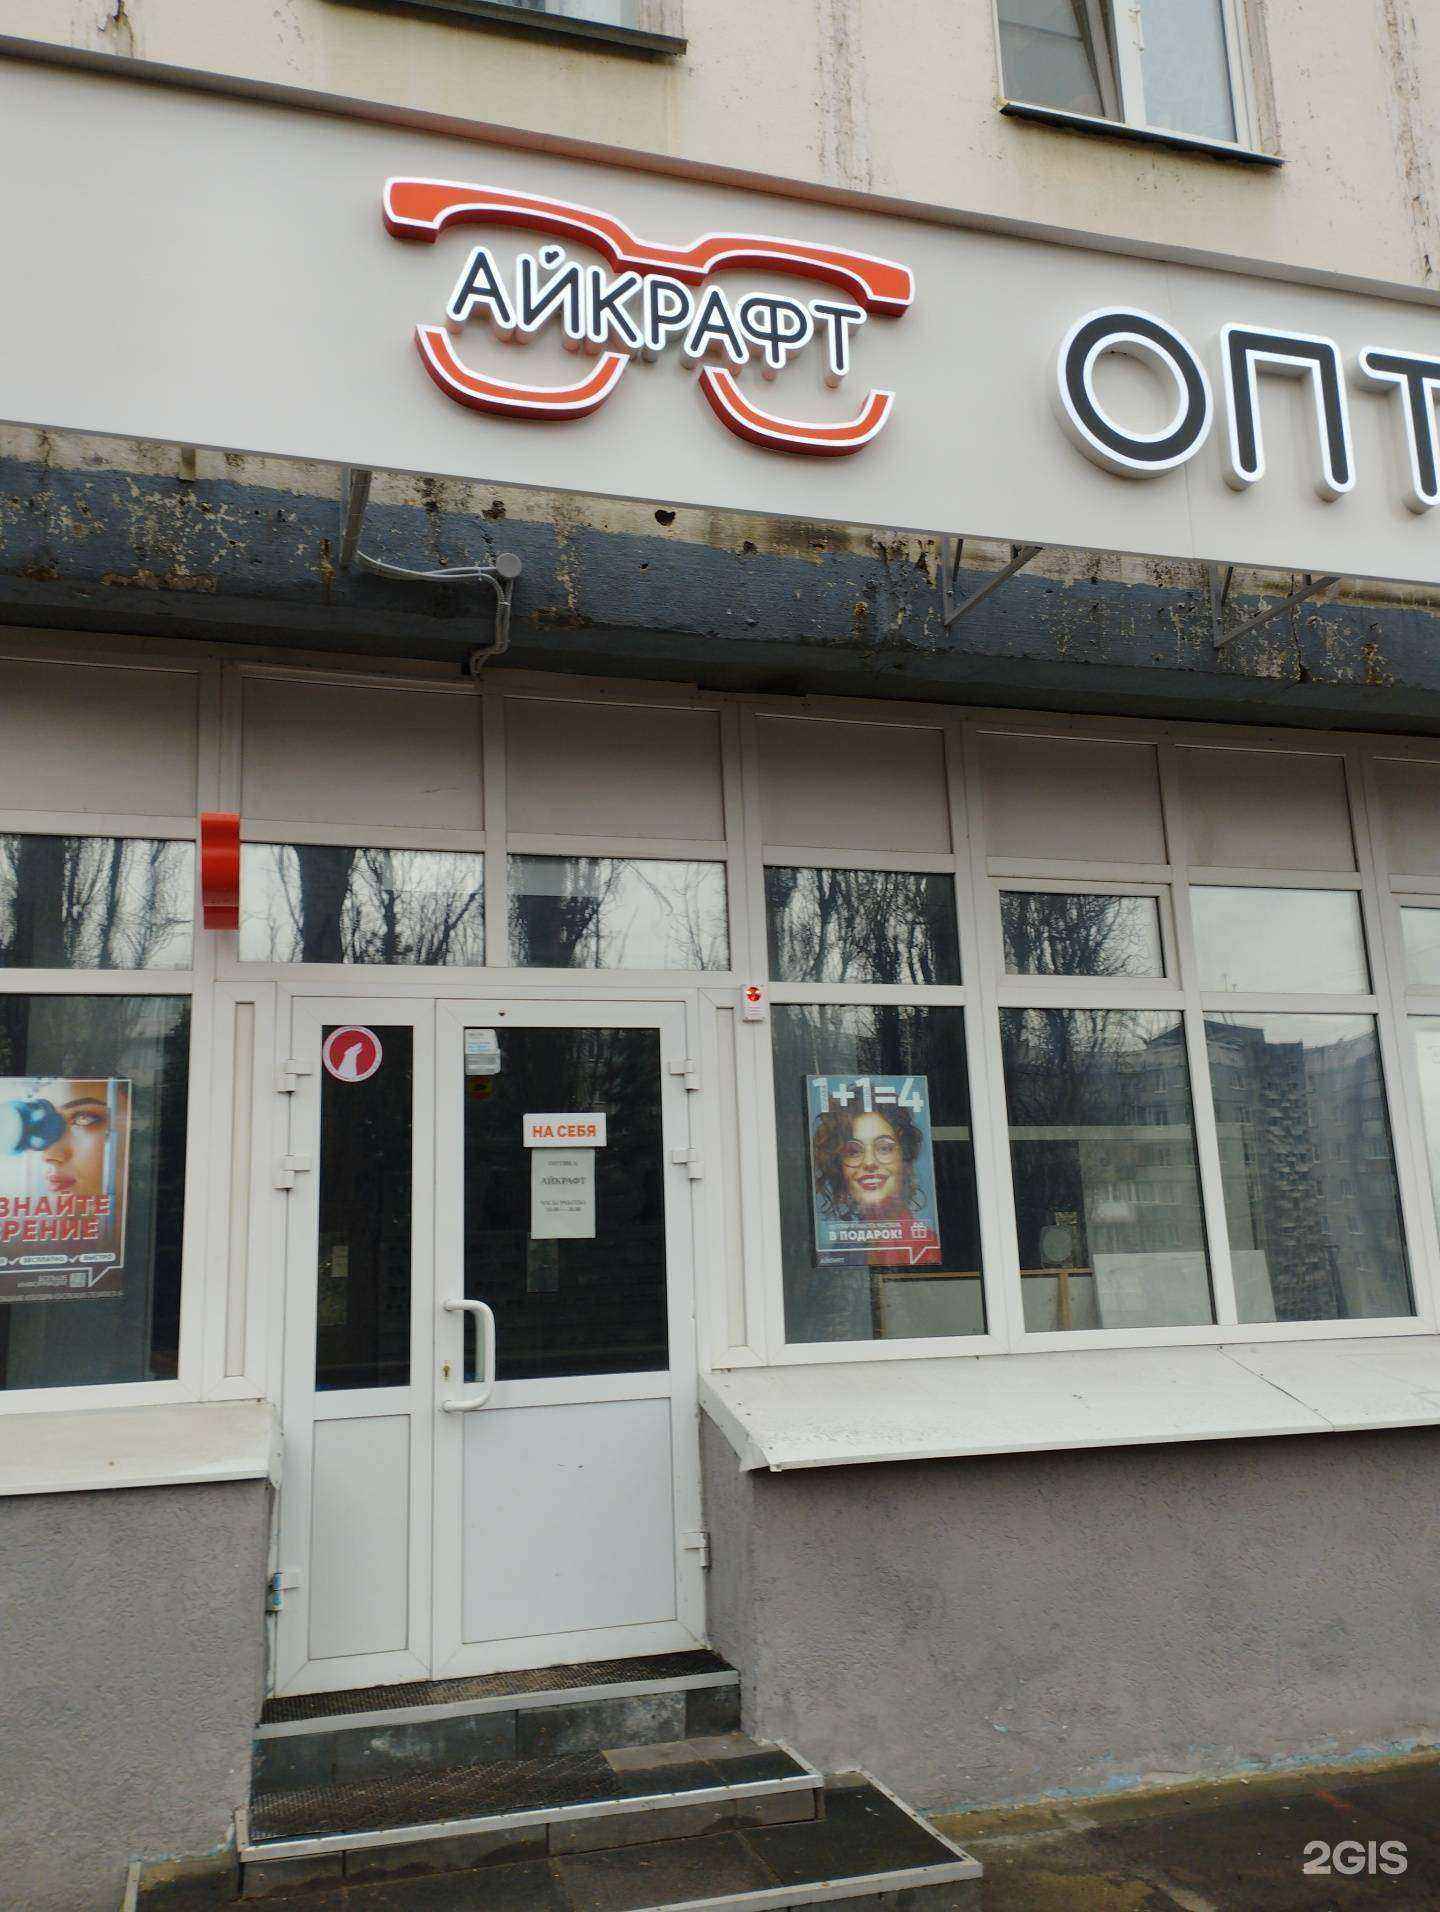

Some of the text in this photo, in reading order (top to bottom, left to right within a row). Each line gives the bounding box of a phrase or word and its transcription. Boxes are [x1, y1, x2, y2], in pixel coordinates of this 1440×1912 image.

[448, 246, 867, 375] АЙКРАФТ
[1057, 306, 1440, 508] ОПТ
[812, 1076, 925, 1113] 1+1=4
[532, 1124, 597, 1138] НА СЕБЯ
[828, 1230, 837, 1240] В
